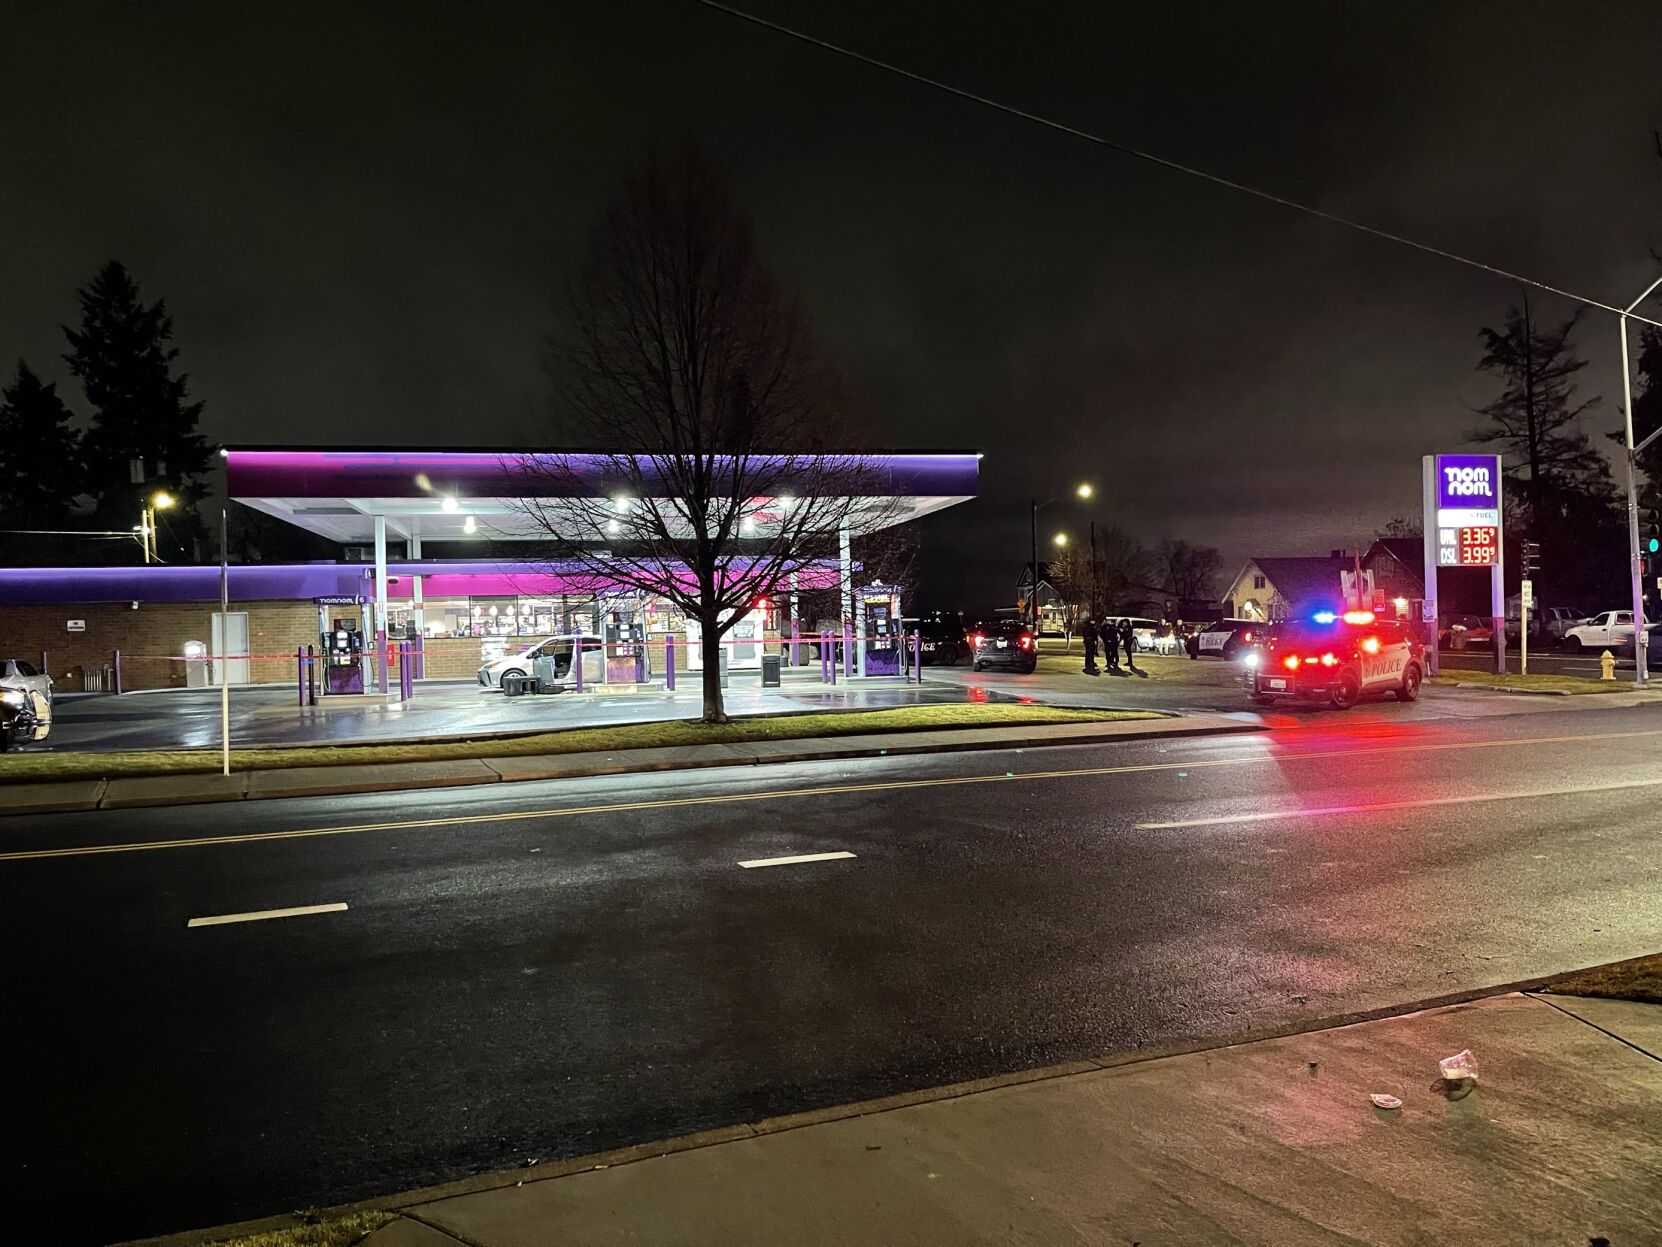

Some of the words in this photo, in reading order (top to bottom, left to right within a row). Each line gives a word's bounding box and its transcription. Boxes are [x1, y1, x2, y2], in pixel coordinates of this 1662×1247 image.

[1444, 467, 1489, 481] nom
[1448, 481, 1492, 496] nom
[1440, 547, 1457, 564] DSL
[1371, 658, 1402, 677] POLICE
